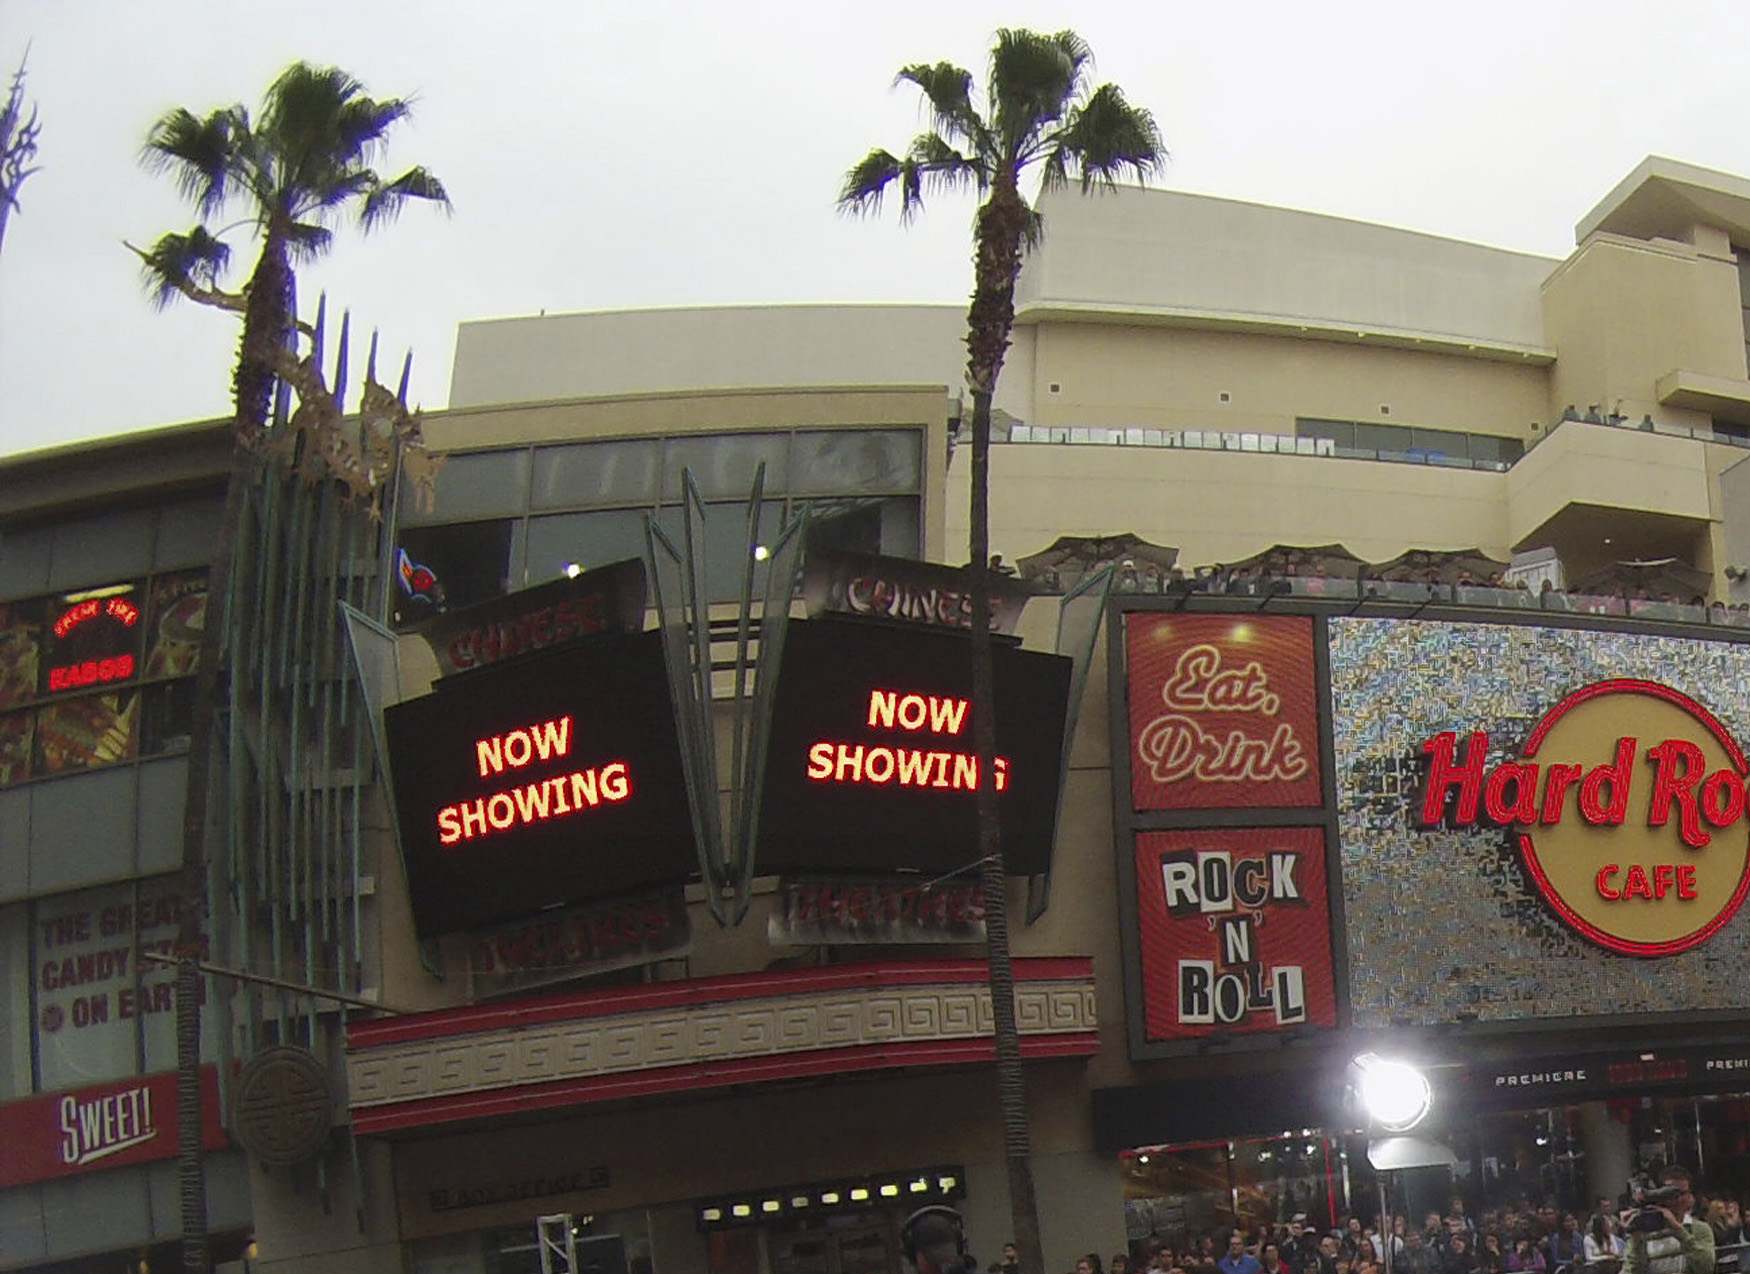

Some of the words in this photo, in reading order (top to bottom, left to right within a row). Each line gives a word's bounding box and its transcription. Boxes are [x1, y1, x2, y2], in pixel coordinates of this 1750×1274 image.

[1163, 645, 1280, 715] Eat.
[868, 689, 968, 735] NOW
[476, 714, 570, 777] NOW
[1139, 714, 1309, 782] Drink
[437, 762, 630, 845] SHOWING
[1422, 731, 1637, 827] Hard
[1162, 851, 1300, 911] ROCK
[1597, 864, 1698, 900] CAFE
[42, 947, 130, 990] CANDY
[1178, 960, 1306, 1024] ROLL
[72, 993, 109, 1028] ON
[1495, 1069, 1588, 1087] PREMIERE
